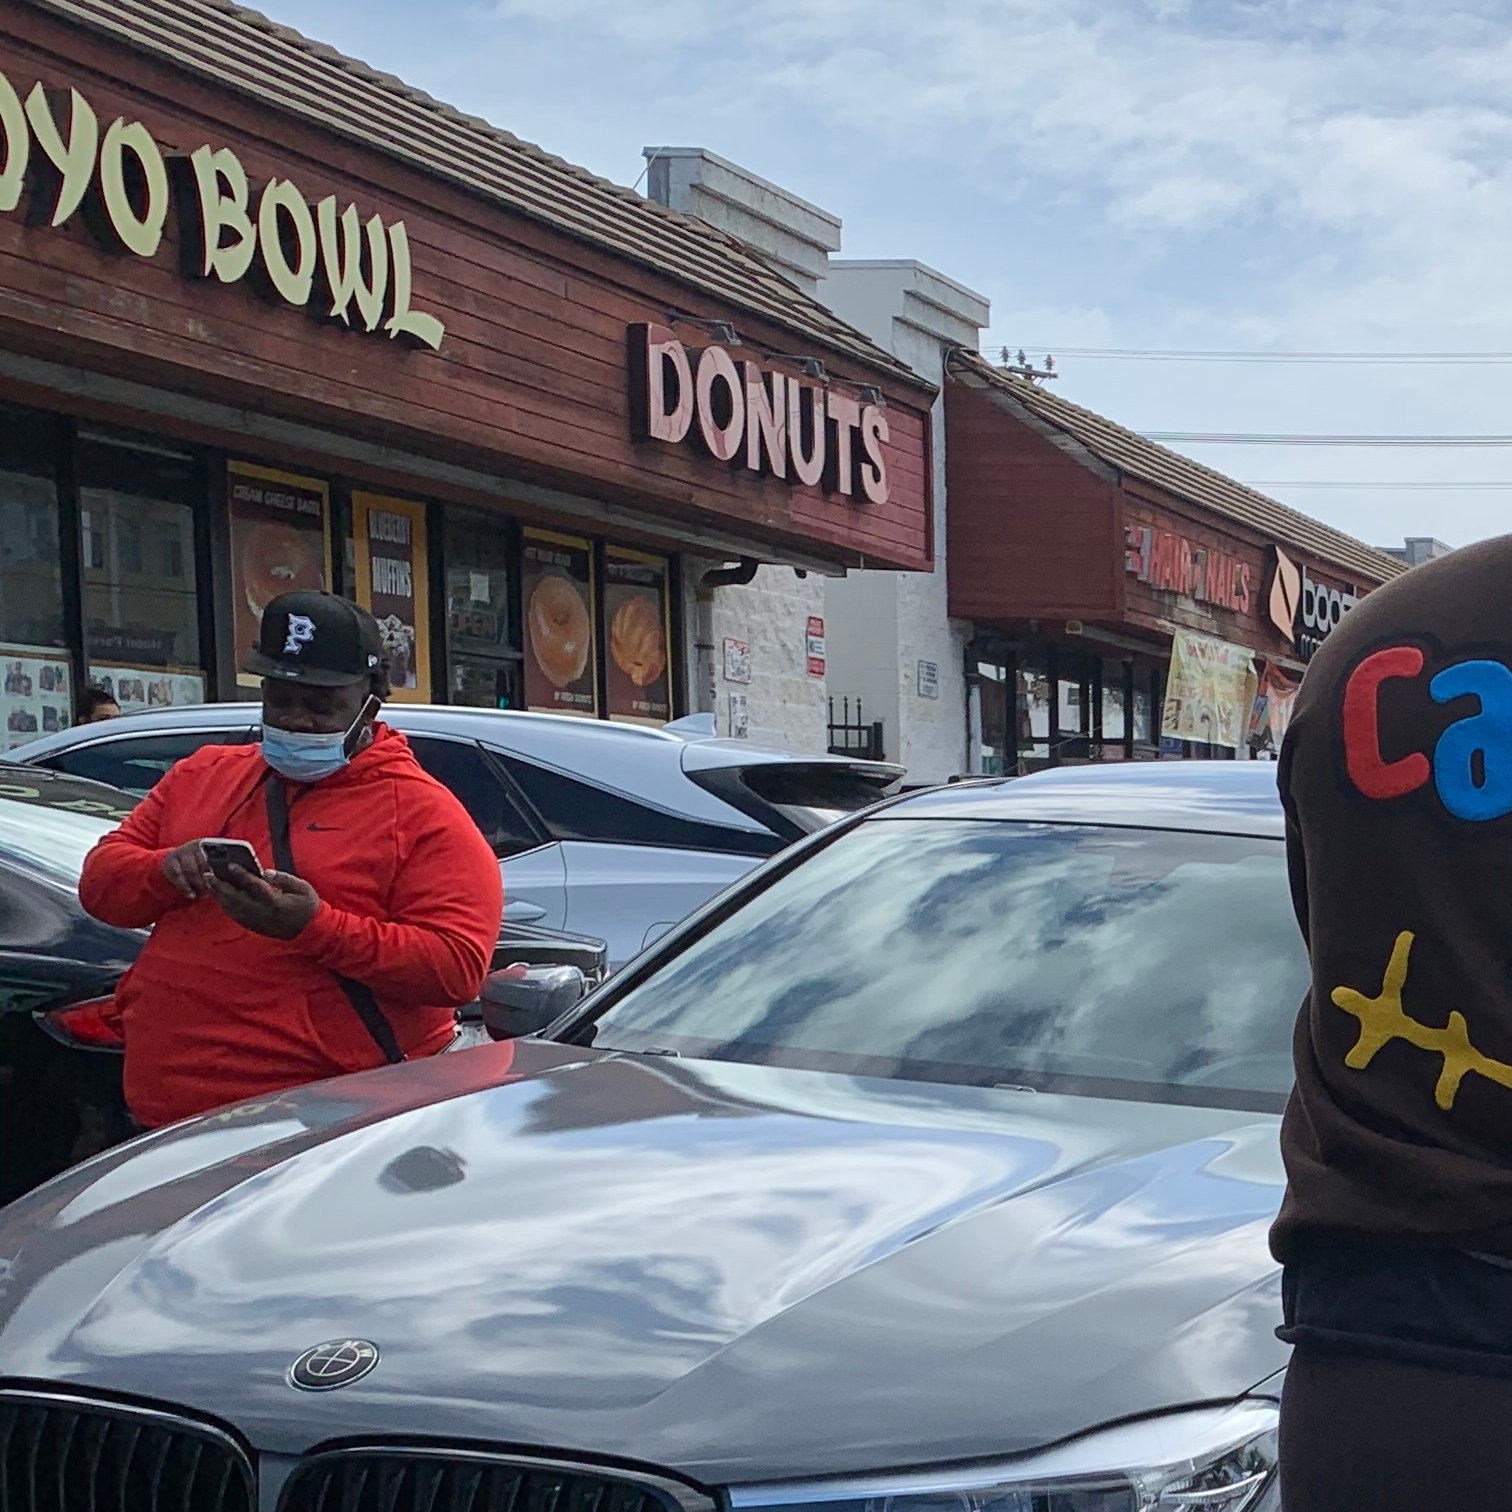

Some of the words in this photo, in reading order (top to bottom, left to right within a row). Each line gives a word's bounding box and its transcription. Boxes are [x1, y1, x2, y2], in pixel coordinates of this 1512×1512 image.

[191, 144, 445, 351] BOWL
[648, 322, 891, 505] DONUTS
[1205, 548, 1250, 613] NAILS
